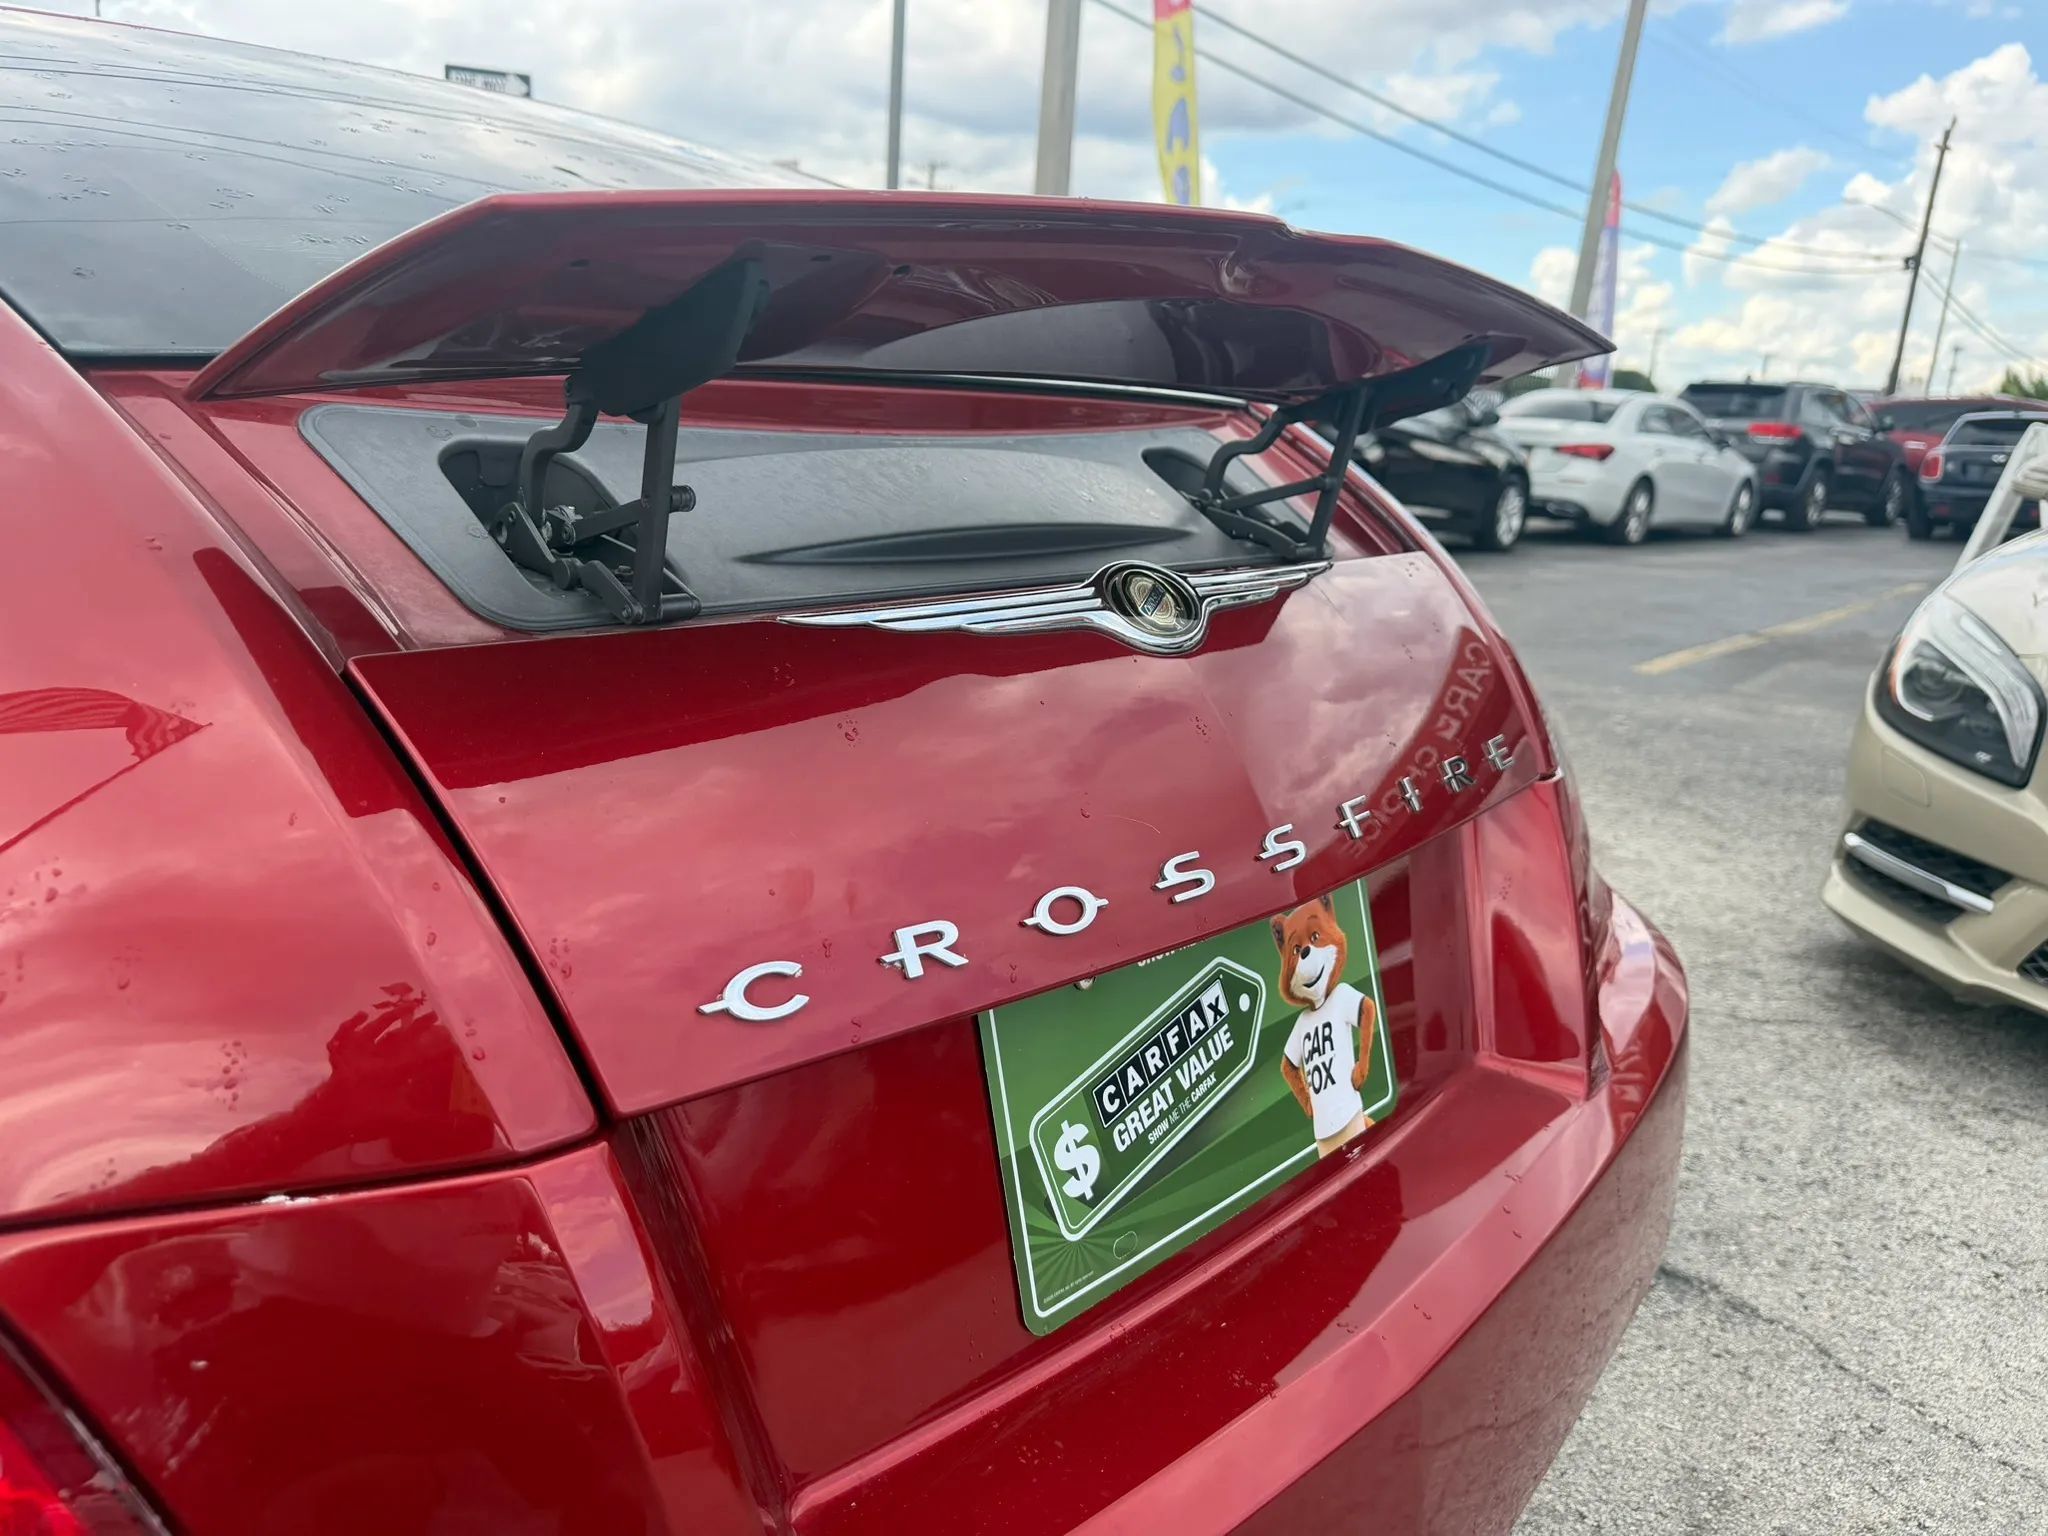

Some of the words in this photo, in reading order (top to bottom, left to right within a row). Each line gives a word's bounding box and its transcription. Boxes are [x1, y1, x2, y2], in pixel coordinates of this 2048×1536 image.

[697, 733, 1515, 1022] CROSSFIRE
[1101, 994, 1225, 1113] CARFAX
[1113, 1078, 1174, 1152] GREAT
[1175, 1024, 1234, 1091] VALUE
[1303, 1021, 1335, 1065] CAR
[1148, 1118, 1169, 1145] SHOW
[1168, 1108, 1181, 1125] ME
[1179, 1096, 1192, 1115] THE
[1190, 1071, 1217, 1103] CARFAX
